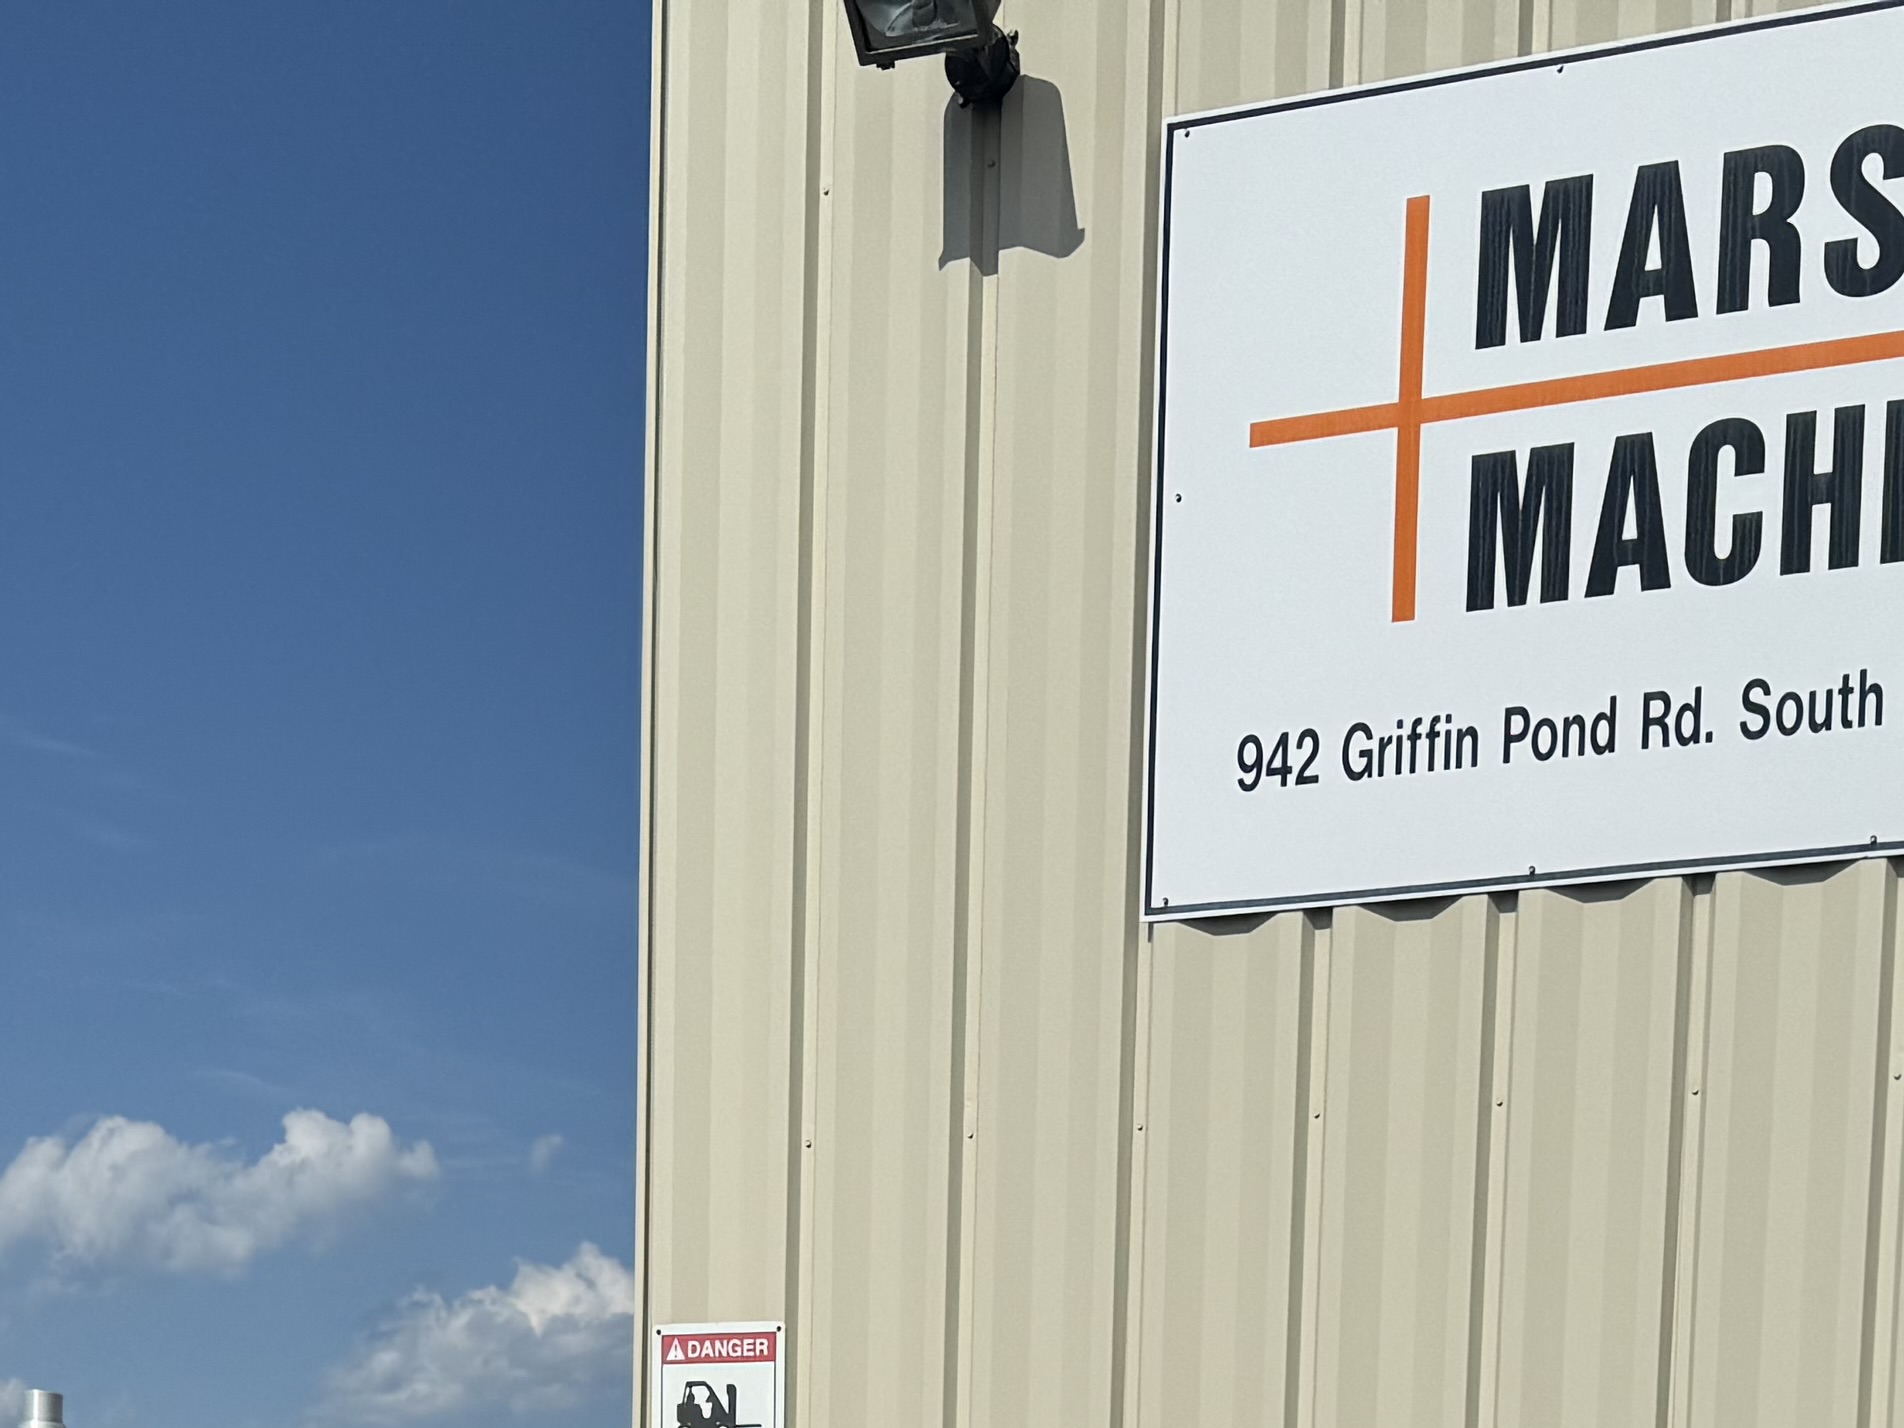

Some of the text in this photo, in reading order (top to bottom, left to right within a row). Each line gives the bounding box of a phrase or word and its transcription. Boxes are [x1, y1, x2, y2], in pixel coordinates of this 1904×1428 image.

[1237, 728, 1320, 792] 942
[1342, 715, 1479, 782] Griffin
[1502, 695, 1617, 764] Pond
[1641, 686, 1712, 750] Rd.
[1739, 667, 1883, 740] South
[687, 1338, 769, 1359] DANGER
